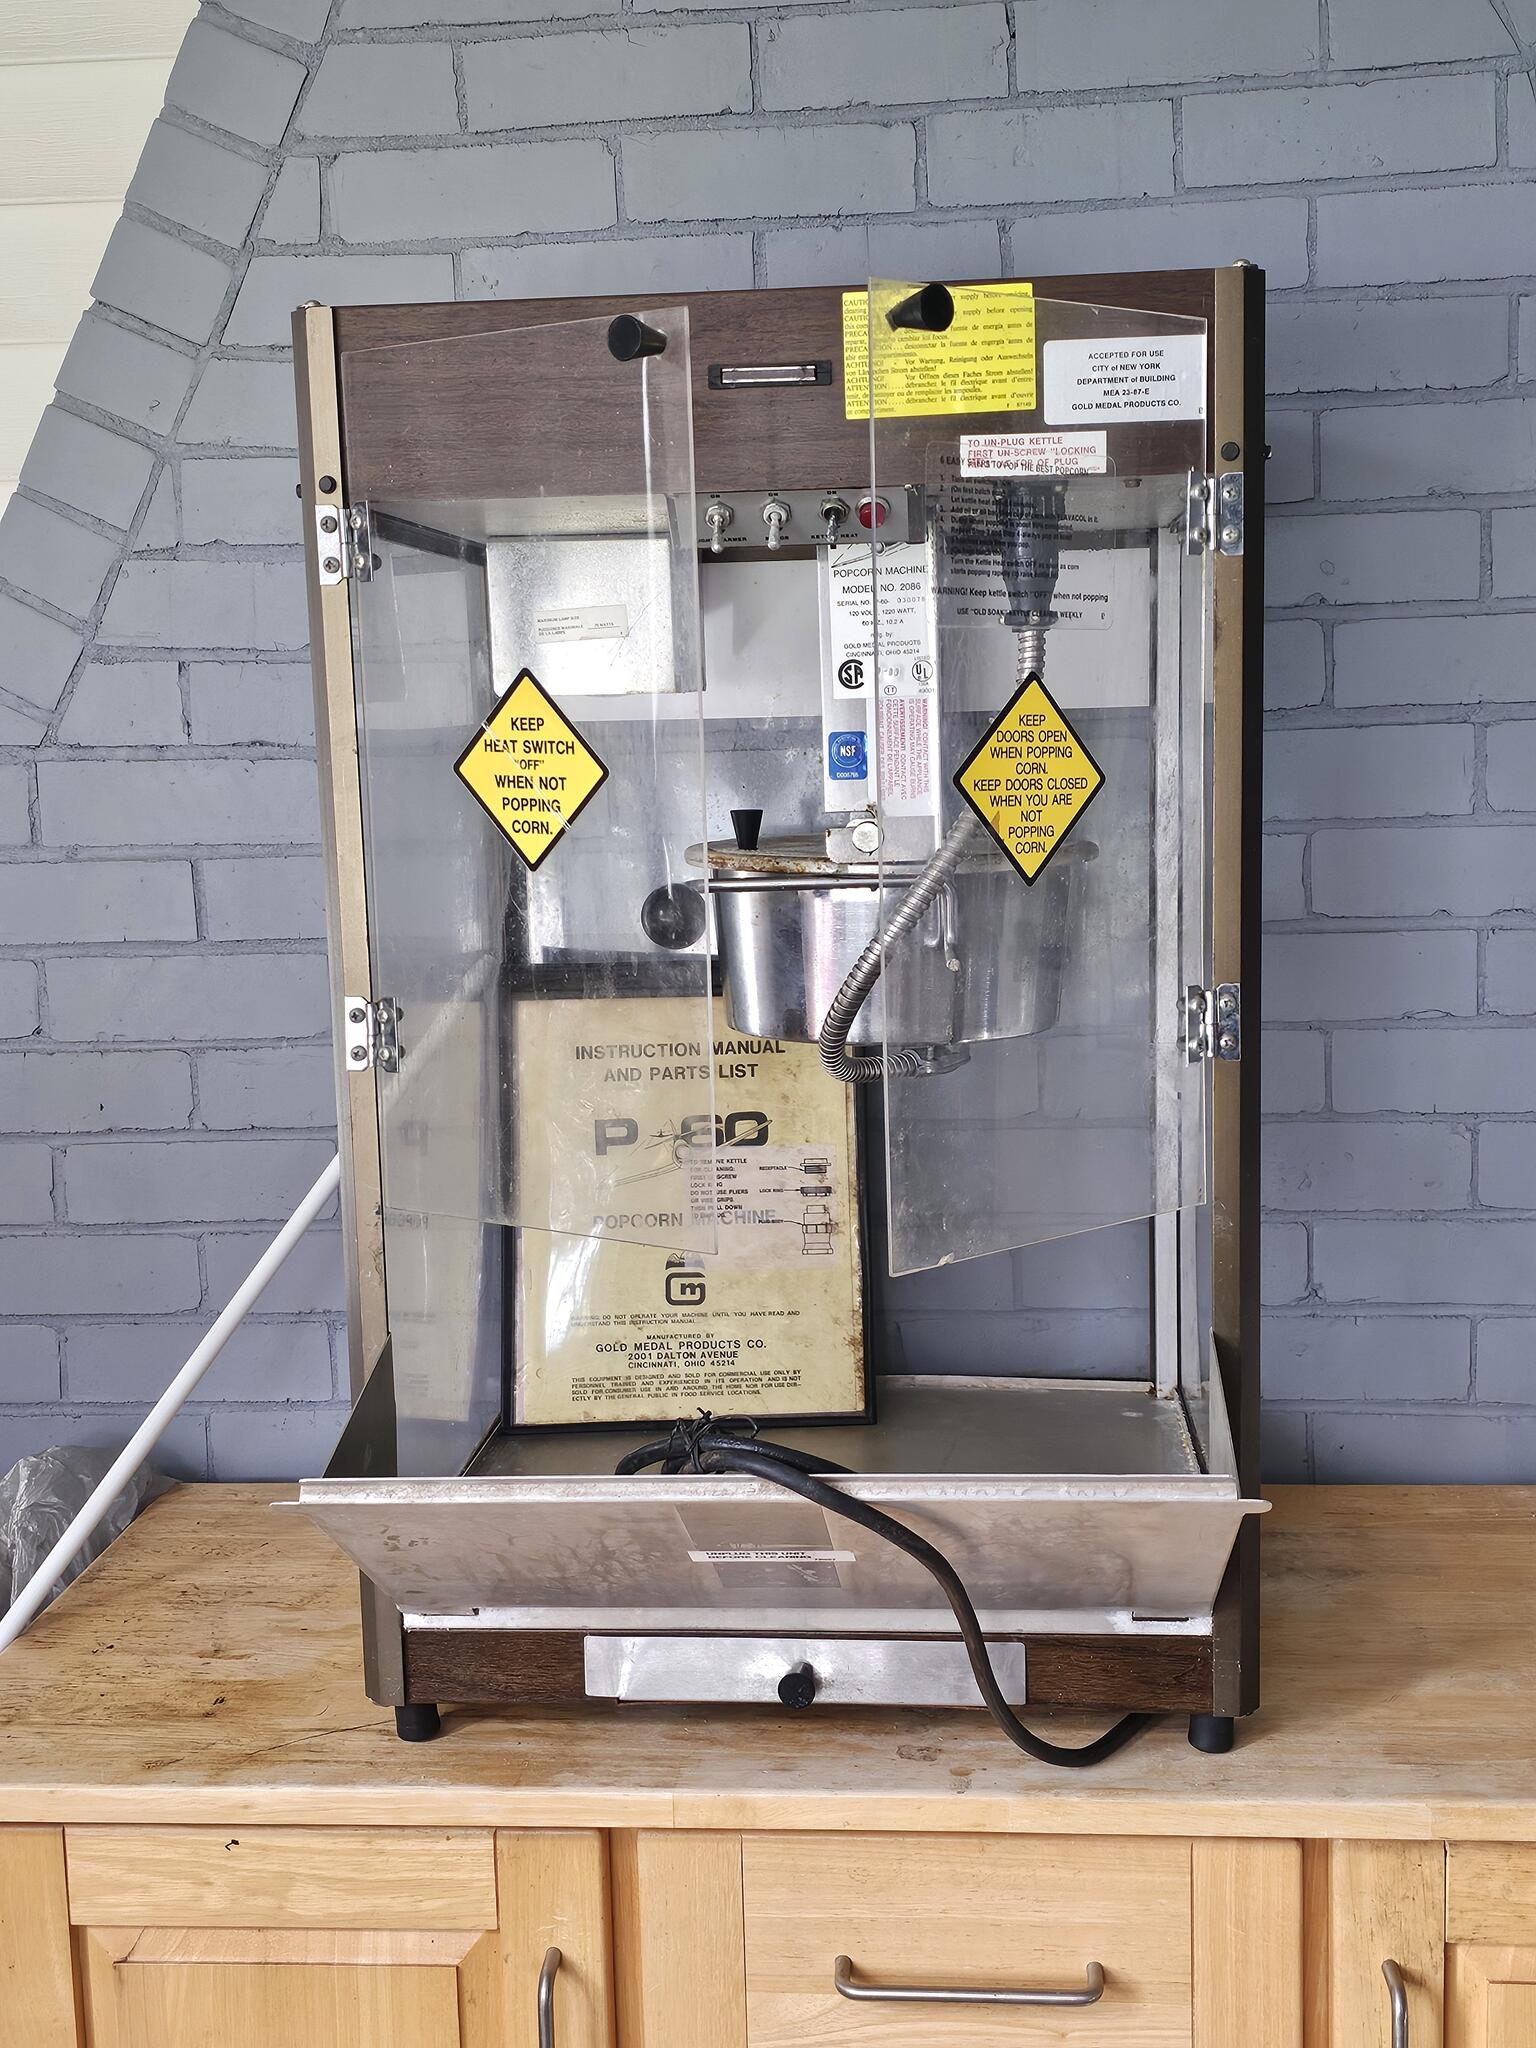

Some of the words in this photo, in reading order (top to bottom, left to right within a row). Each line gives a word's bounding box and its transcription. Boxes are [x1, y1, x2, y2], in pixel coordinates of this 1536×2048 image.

[1088, 351, 1129, 360] ACCEPTED
[1131, 350, 1147, 358] FOR
[1149, 350, 1164, 358] USE
[1092, 364, 1109, 372] CITY
[1119, 363, 1137, 371] NEW
[1139, 362, 1161, 370] YORK
[1076, 377, 1129, 386] DEPARTMENT
[1130, 376, 1138, 384] of
[1139, 374, 1176, 383] BUILDING
[1103, 389, 1120, 397] MEA
[1122, 388, 1150, 396] 23-87-E
[1071, 402, 1093, 411] GOLD
[1095, 401, 1122, 410] MEDAL
[1124, 400, 1166, 409] PRODUCTS
[1168, 399, 1182, 407] CO.
[967, 439, 980, 448] TO
[1029, 436, 1063, 446] KETTLE
[967, 449, 993, 459] FIRST
[997, 447, 1046, 458] UN-SCREW
[946, 456, 966, 466] EASY
[1020, 462, 1034, 472] THE
[1035, 463, 1053, 473] BEST
[1054, 457, 1079, 466] PLUG
[833, 567, 882, 578] POPCORN
[885, 565, 928, 575] MACHINE
[842, 584, 874, 594] MODEL
[880, 583, 897, 592] NO.
[900, 582, 921, 591] 2086
[969, 587, 987, 598] Keep
[988, 588, 1007, 598] kettle
[1053, 591, 1071, 600] when
[1071, 592, 1082, 601] not
[1082, 592, 1109, 603] popping
[957, 607, 969, 615] USE
[886, 640, 922, 648] PRODUCTS
[885, 648, 902, 656] OHIO
[511, 717, 544, 731] KEEP
[1018, 714, 1046, 727] KEEP
[996, 730, 1035, 743] DOORS
[1038, 730, 1068, 743] OPEN
[484, 739, 517, 753] HEAT
[523, 740, 575, 755] SWITCH
[840, 745, 856, 757] NSF
[990, 746, 1023, 759] WHEN
[1026, 746, 1073, 759] POPPING
[1015, 762, 1048, 775] CORN.
[494, 774, 534, 789] WHEN
[539, 777, 567, 791] NOT
[973, 779, 1001, 791] KEEP
[1005, 778, 1043, 791] DOORS
[1047, 777, 1088, 790] CLOSED
[502, 797, 561, 813] POPPING
[989, 795, 1022, 807] WHEN
[1027, 794, 1048, 806] YOU
[1052, 793, 1073, 805] ARE
[1020, 810, 1043, 822] NOT
[511, 820, 553, 835] CORN.
[1008, 826, 1055, 839] POPPING
[1015, 842, 1048, 854] CORN.
[575, 1042, 701, 1060] INSTRUCTION
[712, 1040, 786, 1056] MANUAL
[604, 1067, 642, 1082] AND
[650, 1065, 711, 1081] PARTS
[718, 1063, 759, 1079] LIST
[593, 1213, 683, 1230] POPCORN
[691, 1209, 776, 1227] MACHINE
[595, 1342, 628, 1353] GOLD
[634, 1341, 673, 1352] MEDAL
[679, 1339, 741, 1350] PRODUCTS
[747, 1338, 767, 1349] CO.
[628, 1352, 652, 1361] 2001
[657, 1351, 696, 1360] DALTON
[700, 1350, 739, 1359] AVENUE
[628, 1360, 680, 1369] CINCINNATI,
[684, 1359, 706, 1368] OHIO
[710, 1359, 735, 1367] 45214
